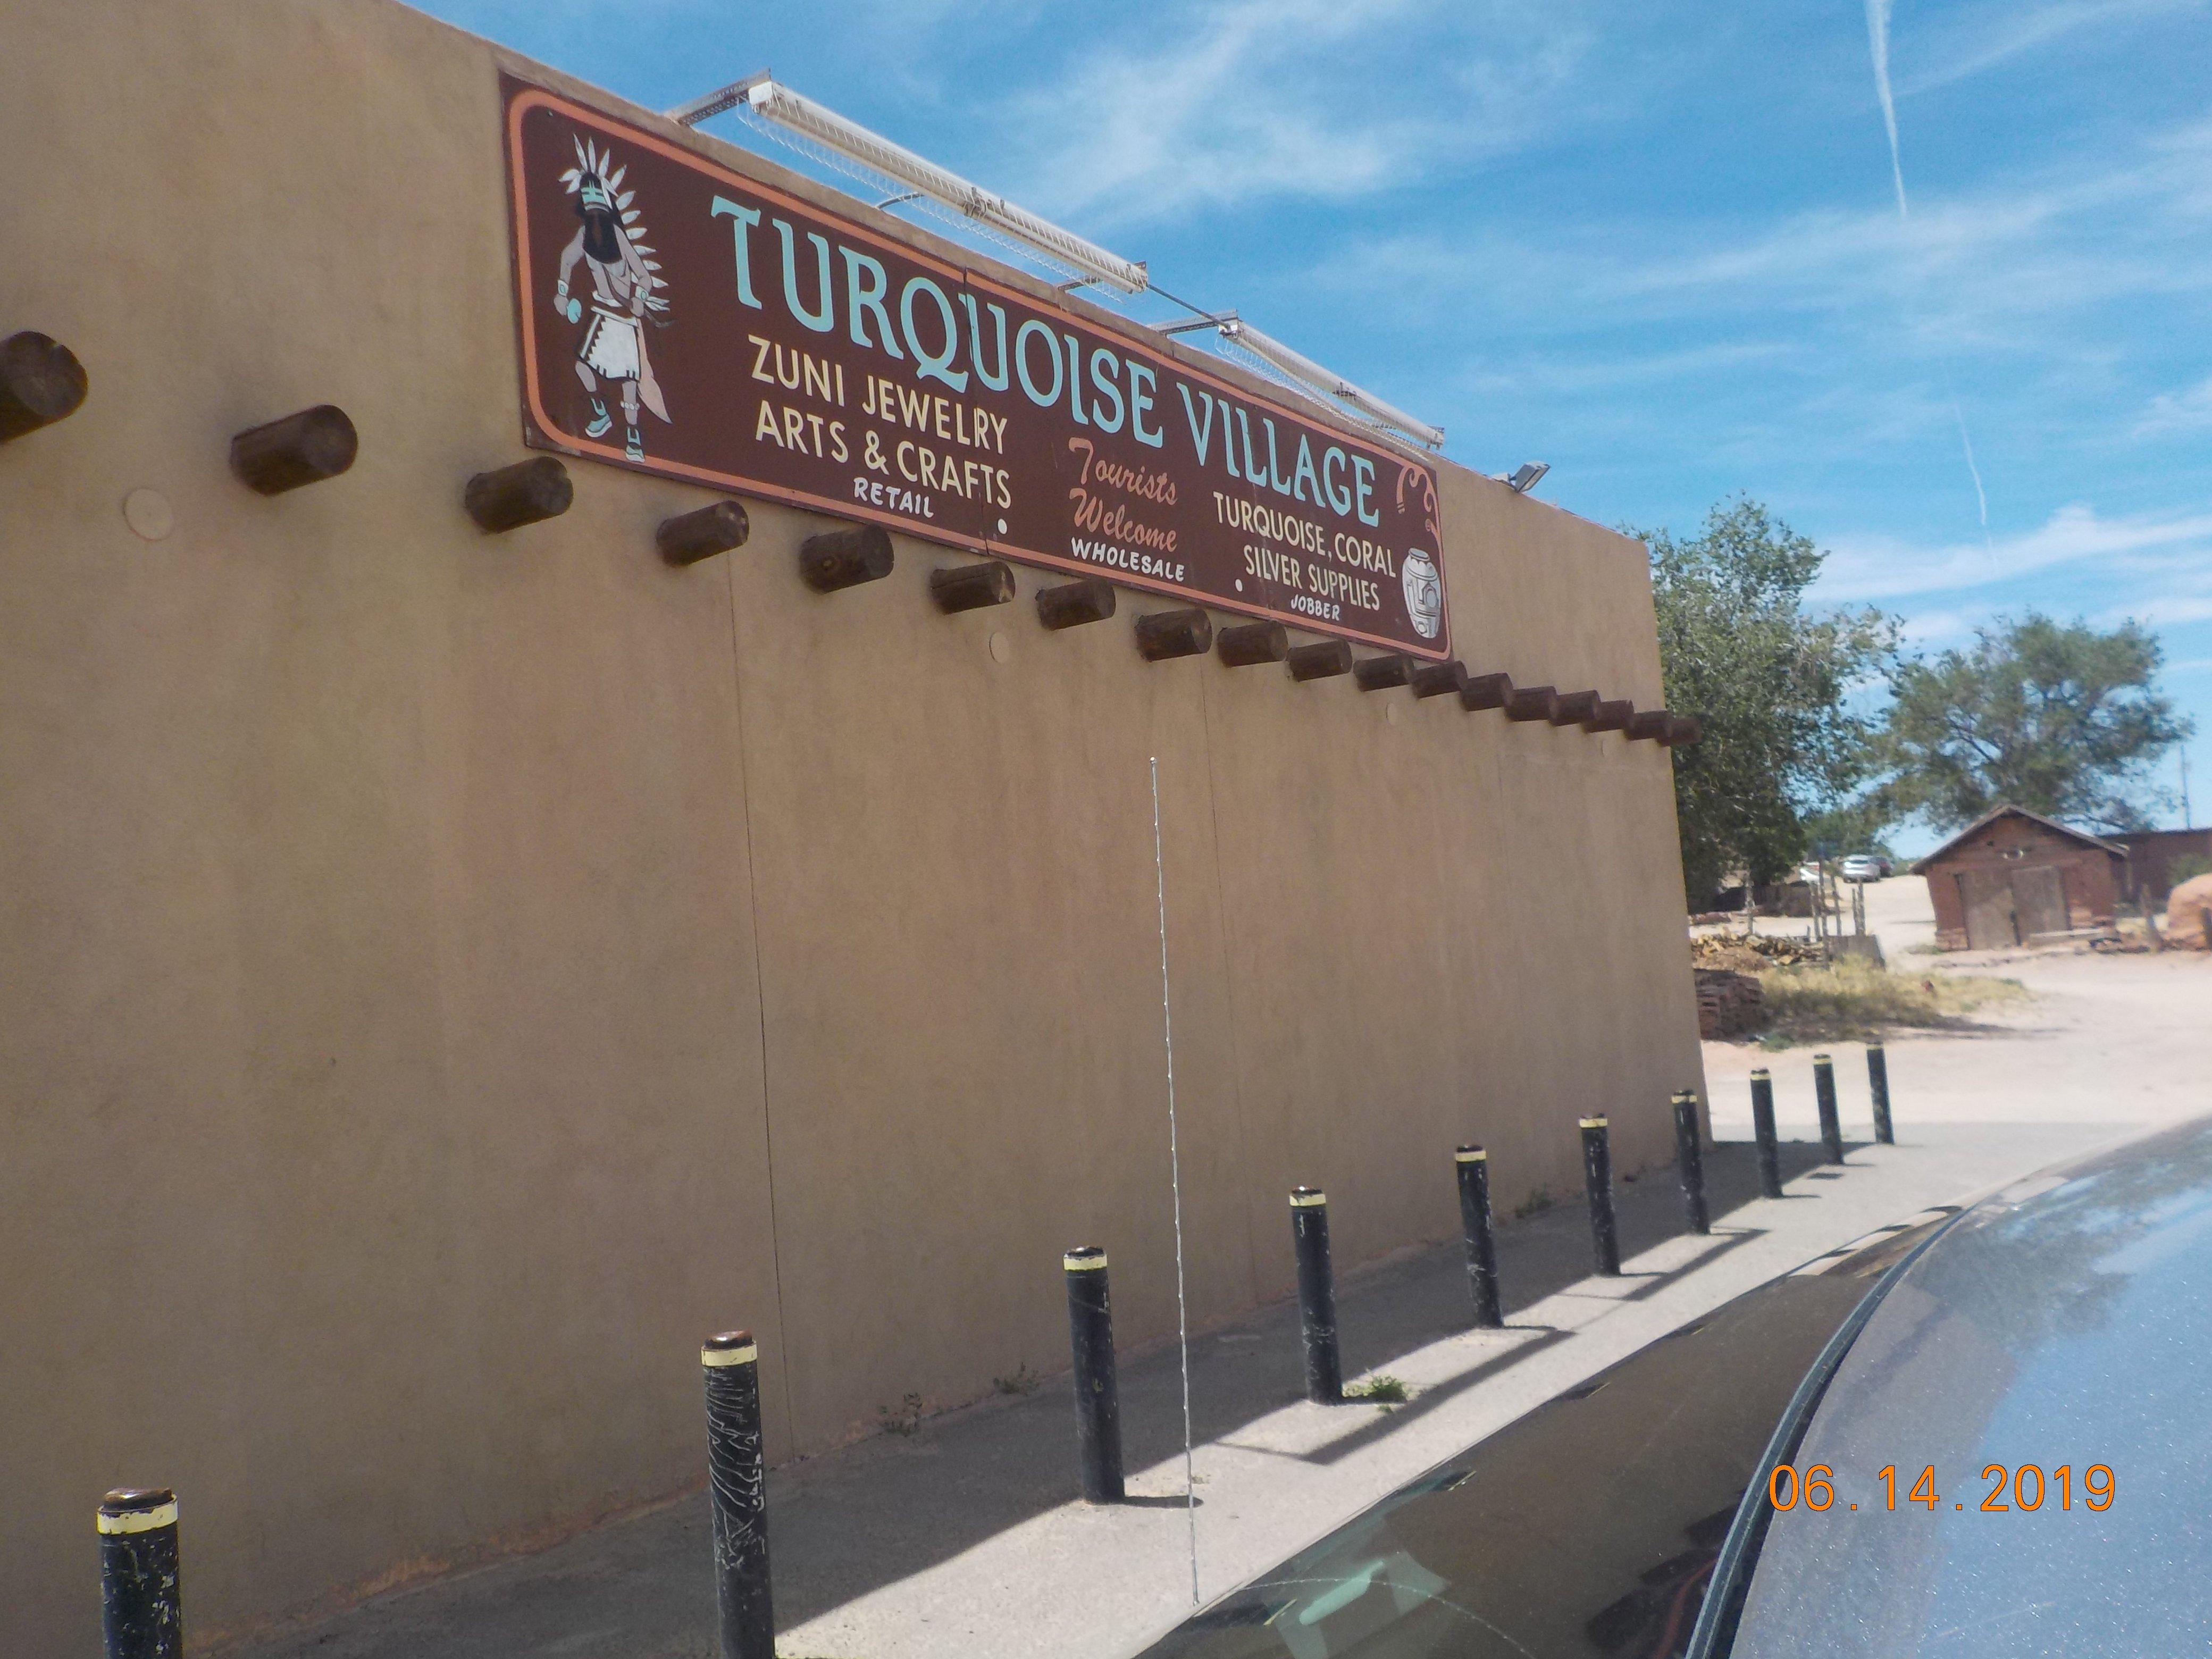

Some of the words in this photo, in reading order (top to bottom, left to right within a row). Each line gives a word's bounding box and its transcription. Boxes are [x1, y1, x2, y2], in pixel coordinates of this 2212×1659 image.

[711, 195, 1163, 448] TURQUOISE
[1176, 382, 1379, 527] VILLAGE
[749, 334, 844, 407] ZUNI
[862, 376, 1007, 454] JEWELRY
[756, 401, 848, 463] ARTS
[864, 430, 890, 475] &
[897, 441, 1011, 509] CRAFTS
[1068, 437, 1177, 505] Tourists
[853, 477, 934, 517] RETAIL
[1071, 538, 1184, 581] WHOLESALE
[1291, 594, 1339, 621] JOBBER
[1069, 487, 1177, 552] Welcome
[1334, 531, 1396, 576] CORAL
[1244, 546, 1302, 590] SILVER
[1308, 565, 1380, 610] SUPPLIES
